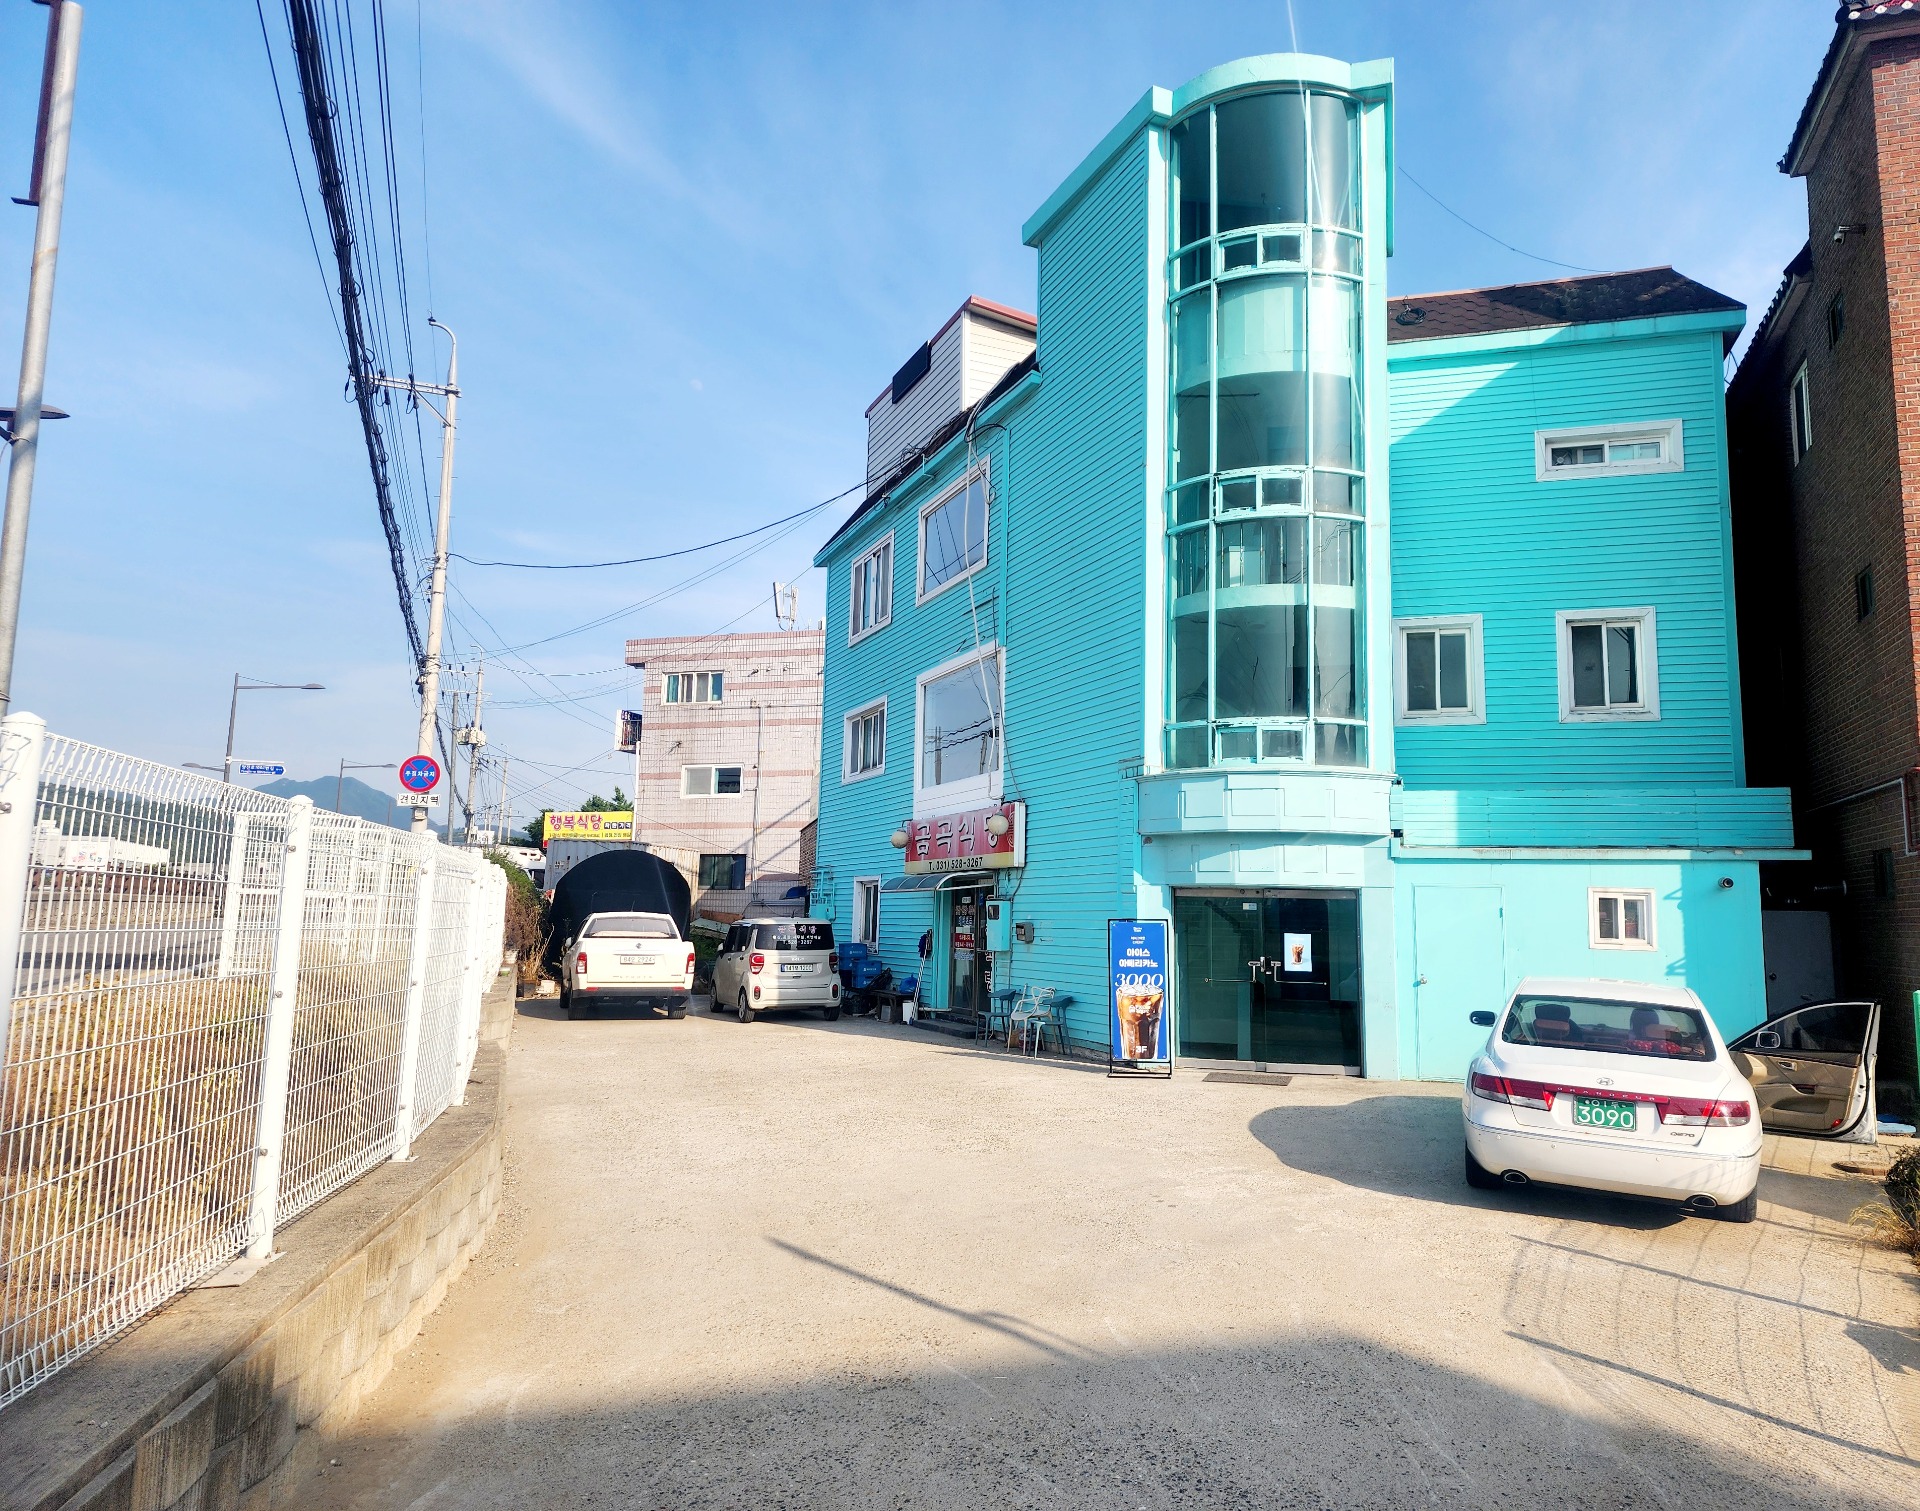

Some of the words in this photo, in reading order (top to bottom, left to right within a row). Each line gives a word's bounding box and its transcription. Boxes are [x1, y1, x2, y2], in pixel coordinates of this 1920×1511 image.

[400, 794, 440, 806] 견인지역
[549, 814, 603, 831] 행복식당
[951, 857, 983, 870] 528-3267
[1126, 947, 1151, 957] 아이스
[1118, 958, 1159, 968] 아메리카노
[1114, 973, 1164, 987] 3000
[1578, 1106, 1633, 1128] 3090
